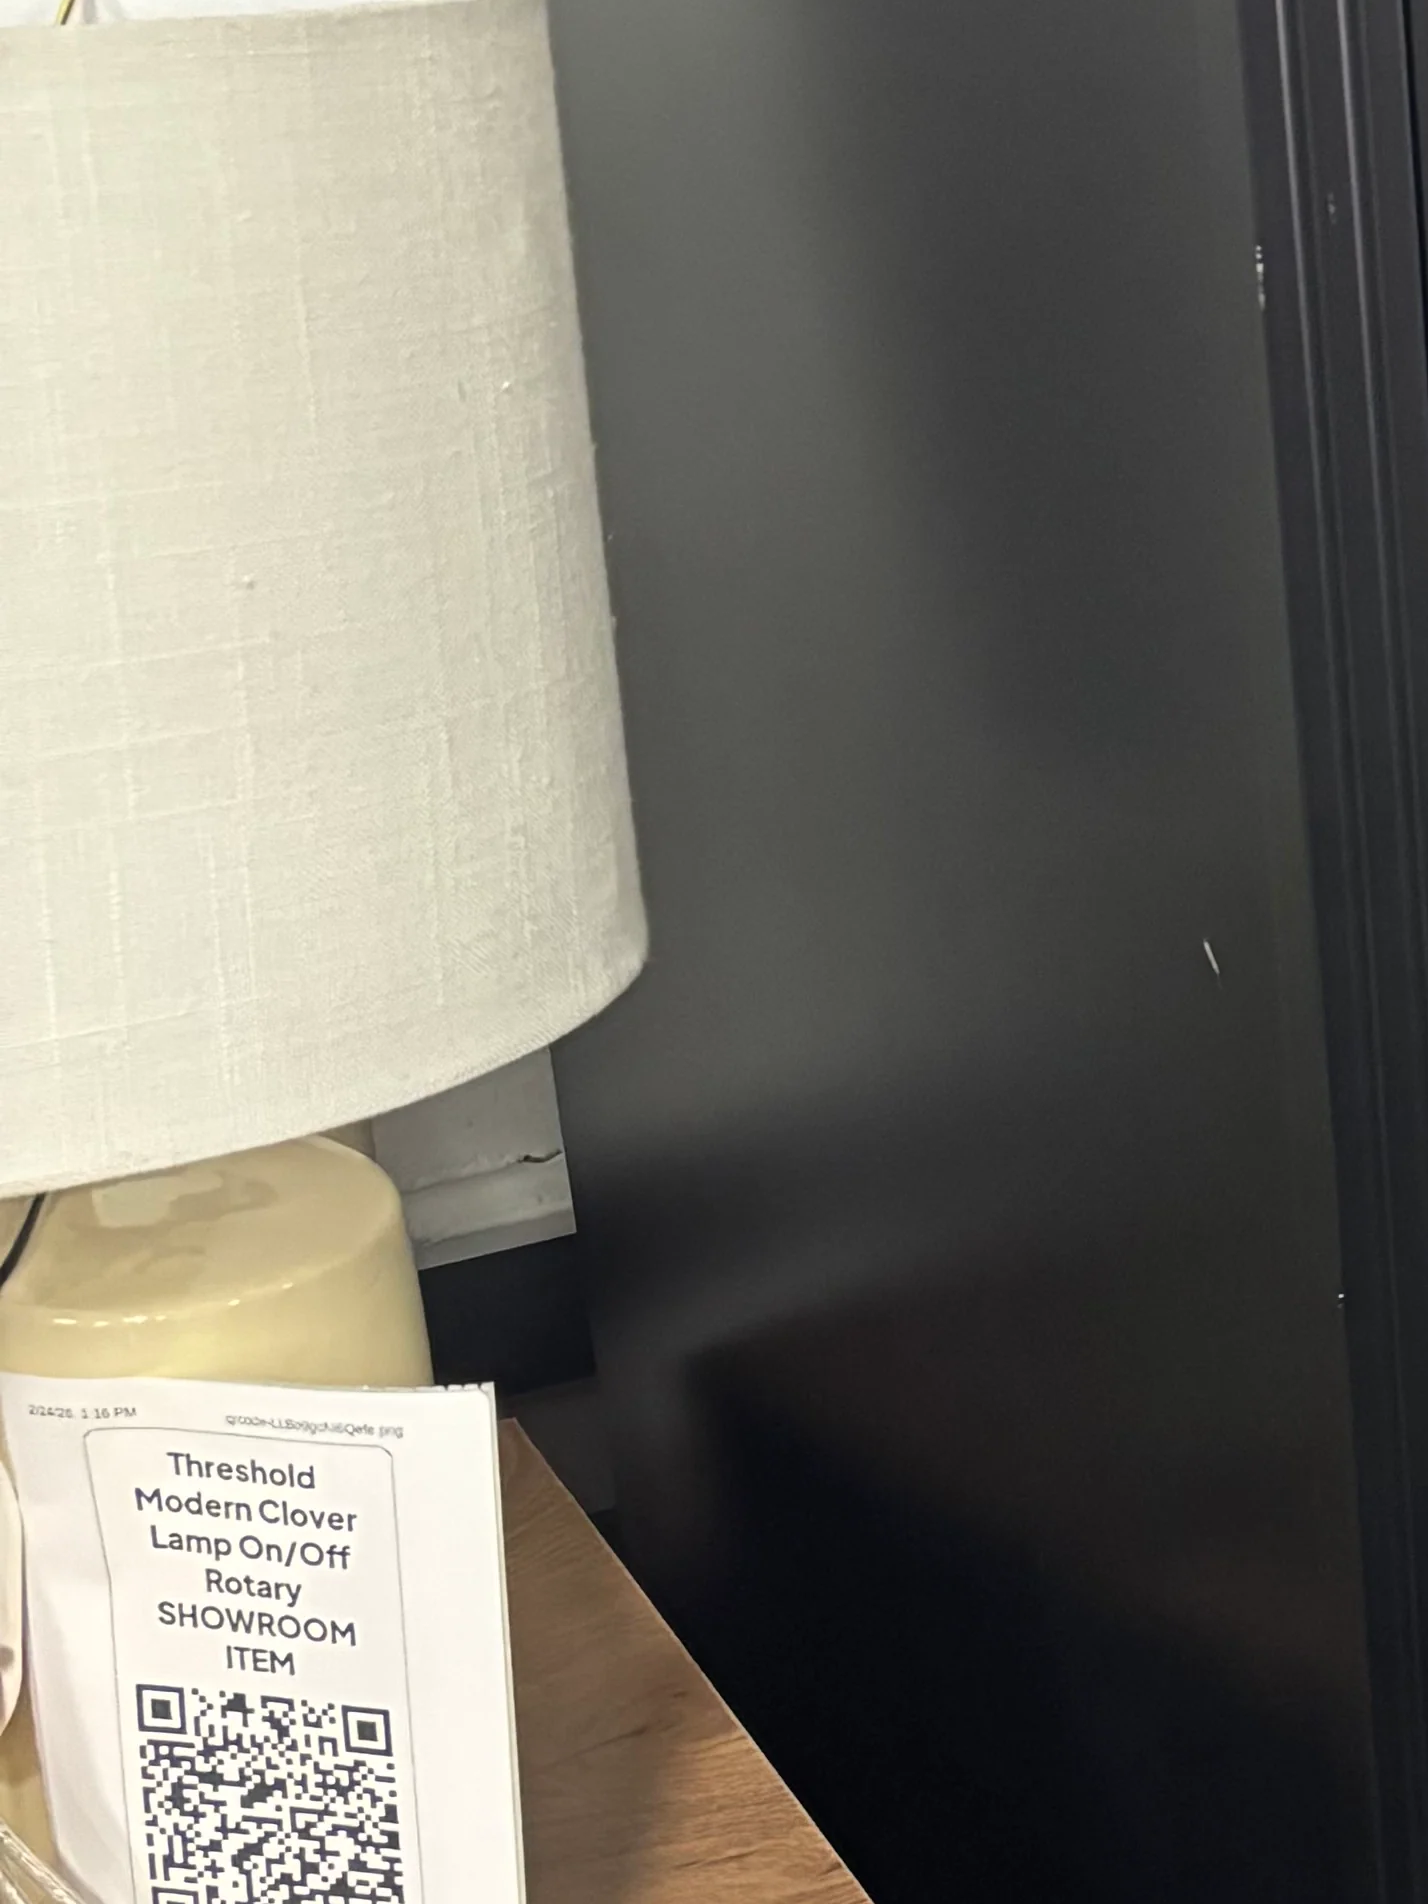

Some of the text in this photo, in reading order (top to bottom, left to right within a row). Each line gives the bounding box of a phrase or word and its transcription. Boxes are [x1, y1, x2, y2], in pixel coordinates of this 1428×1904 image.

[81, 1407, 110, 1419] 116
[114, 1406, 137, 1417] PM
[166, 1451, 316, 1489] Threshold
[134, 1487, 357, 1532] Modern Clover
[150, 1524, 351, 1570] Lamp On/Off
[205, 1568, 302, 1607] Rotary
[158, 1601, 357, 1646] SHOWROOM
[226, 1645, 296, 1675] ITEM
